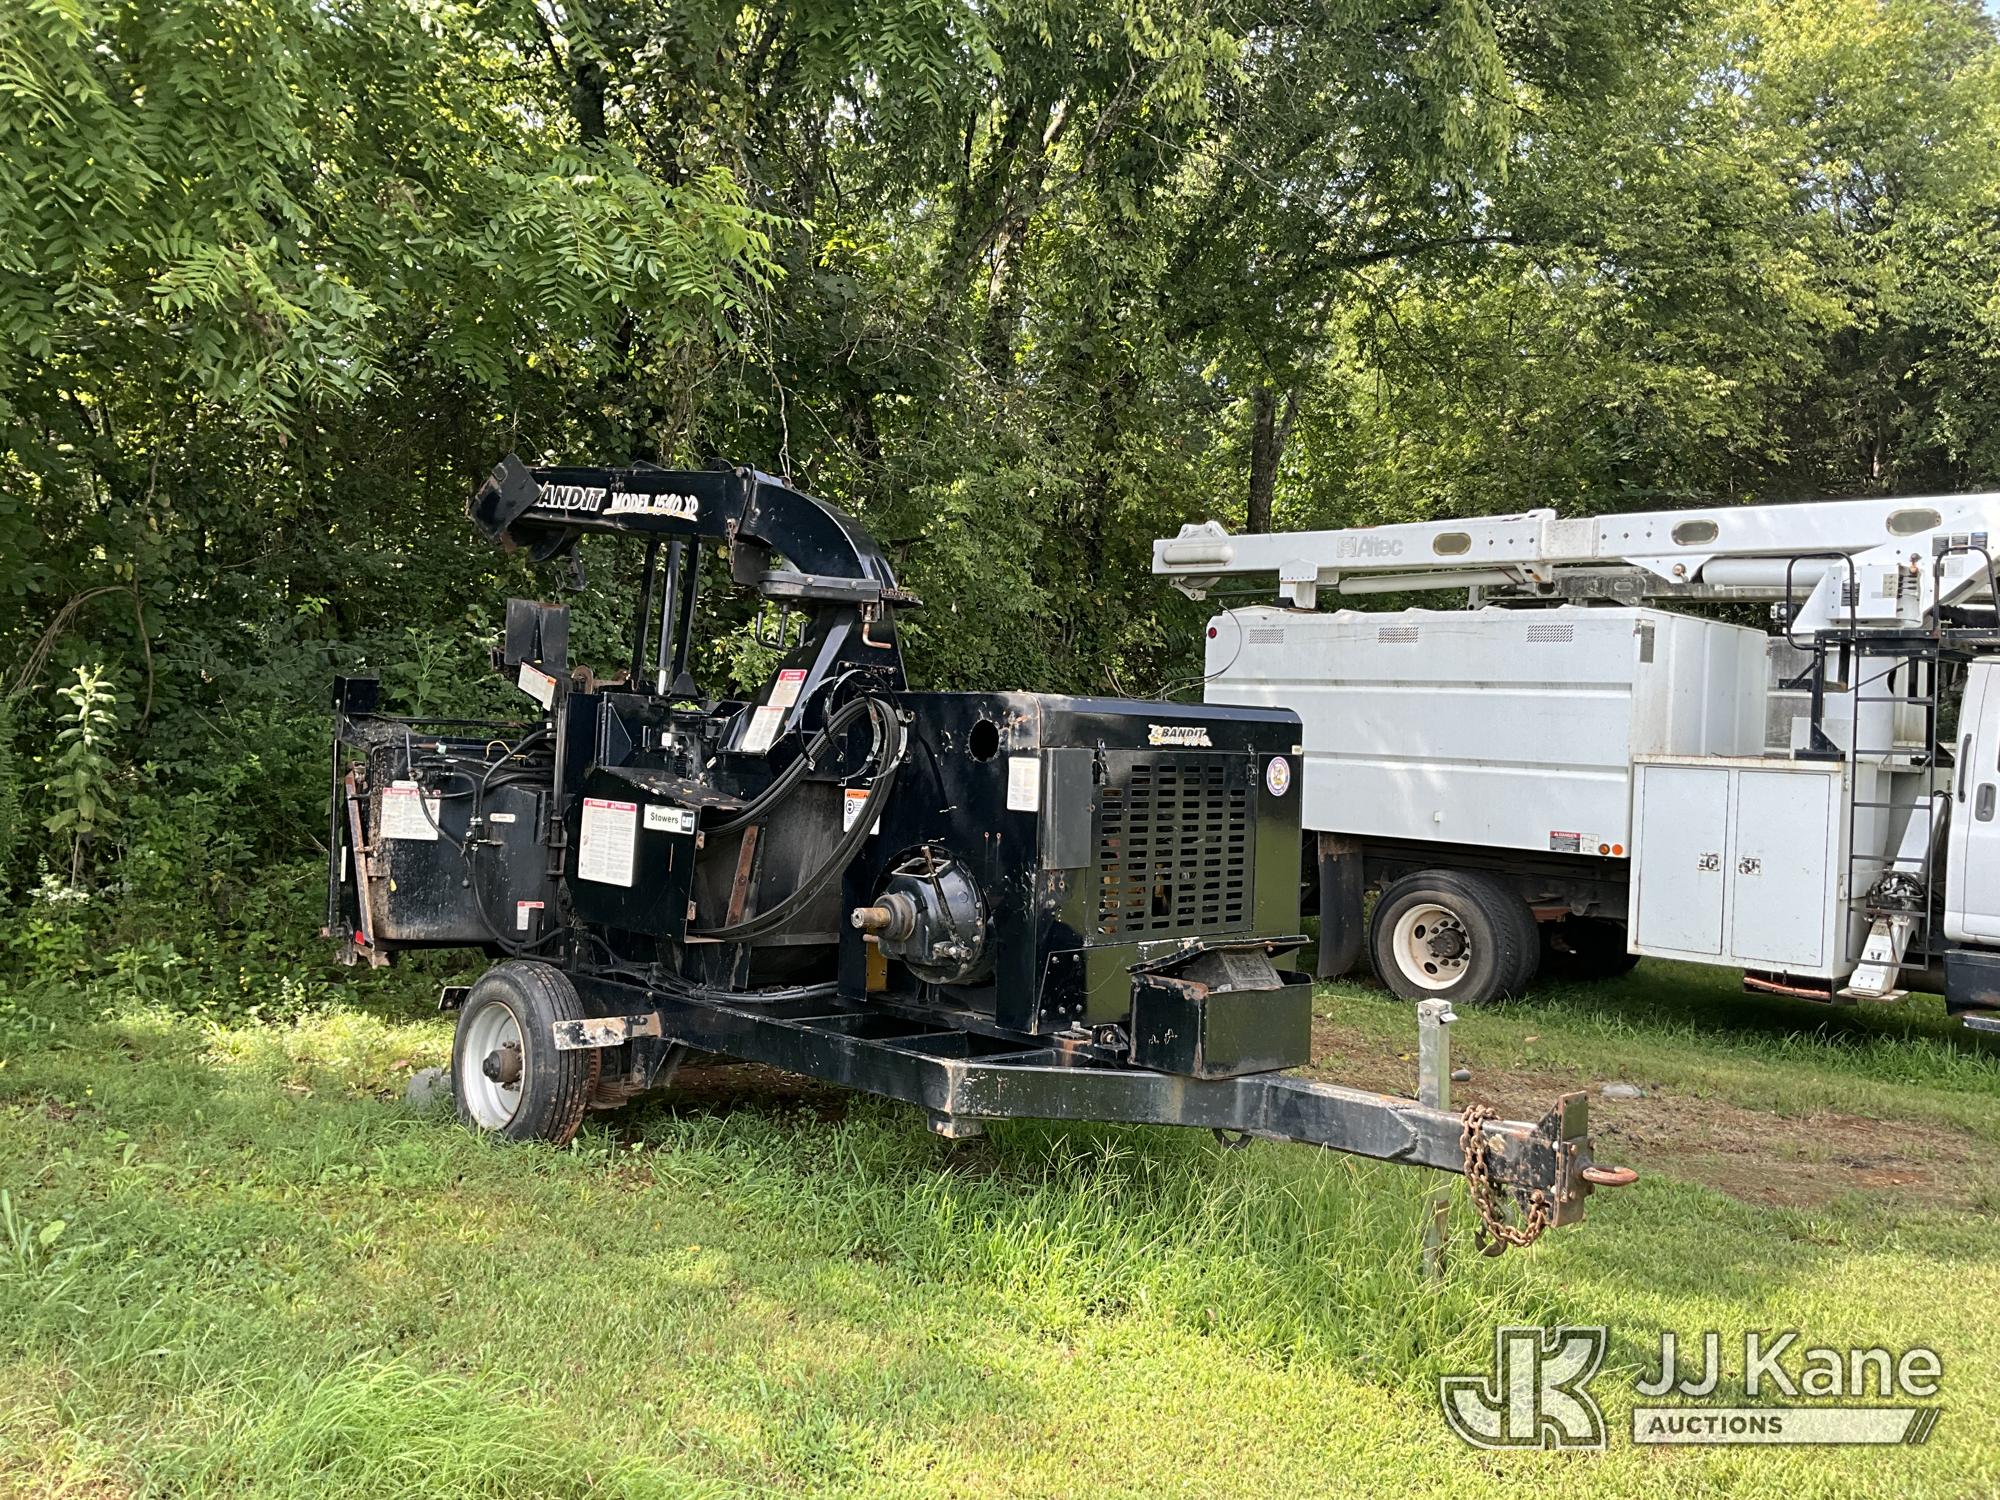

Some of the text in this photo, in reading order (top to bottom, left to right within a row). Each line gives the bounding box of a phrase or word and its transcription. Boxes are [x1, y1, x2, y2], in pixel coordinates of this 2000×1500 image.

[533, 484, 606, 512] ANDIT
[611, 492, 651, 514] MODEL
[684, 495, 699, 517] XP
[1358, 535, 1403, 557] Altec
[1160, 727, 1206, 739] BANDIT
[650, 811, 679, 825] Stowers
